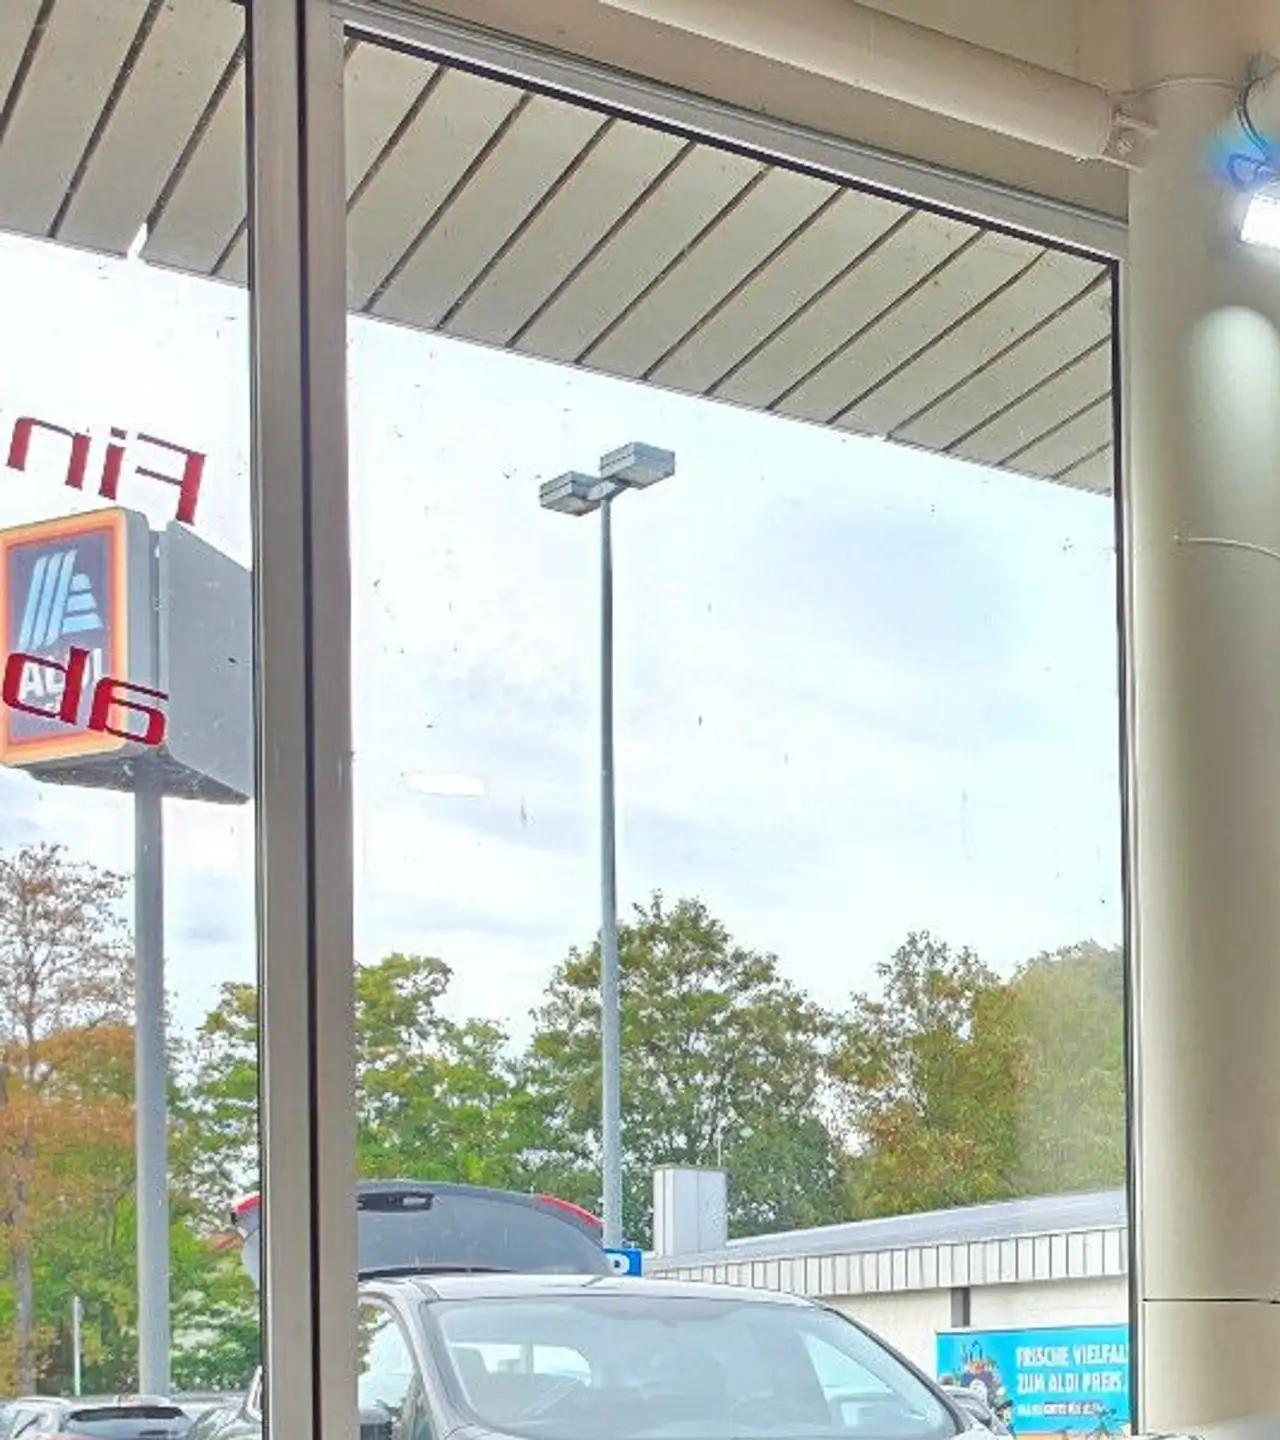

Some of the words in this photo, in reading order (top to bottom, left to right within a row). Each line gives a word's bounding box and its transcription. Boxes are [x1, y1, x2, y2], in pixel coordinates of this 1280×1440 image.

[1072, 1343, 1129, 1365] VIELFAL
[1018, 1373, 1045, 1394] ZUM
[1048, 1372, 1079, 1393] ALDI
